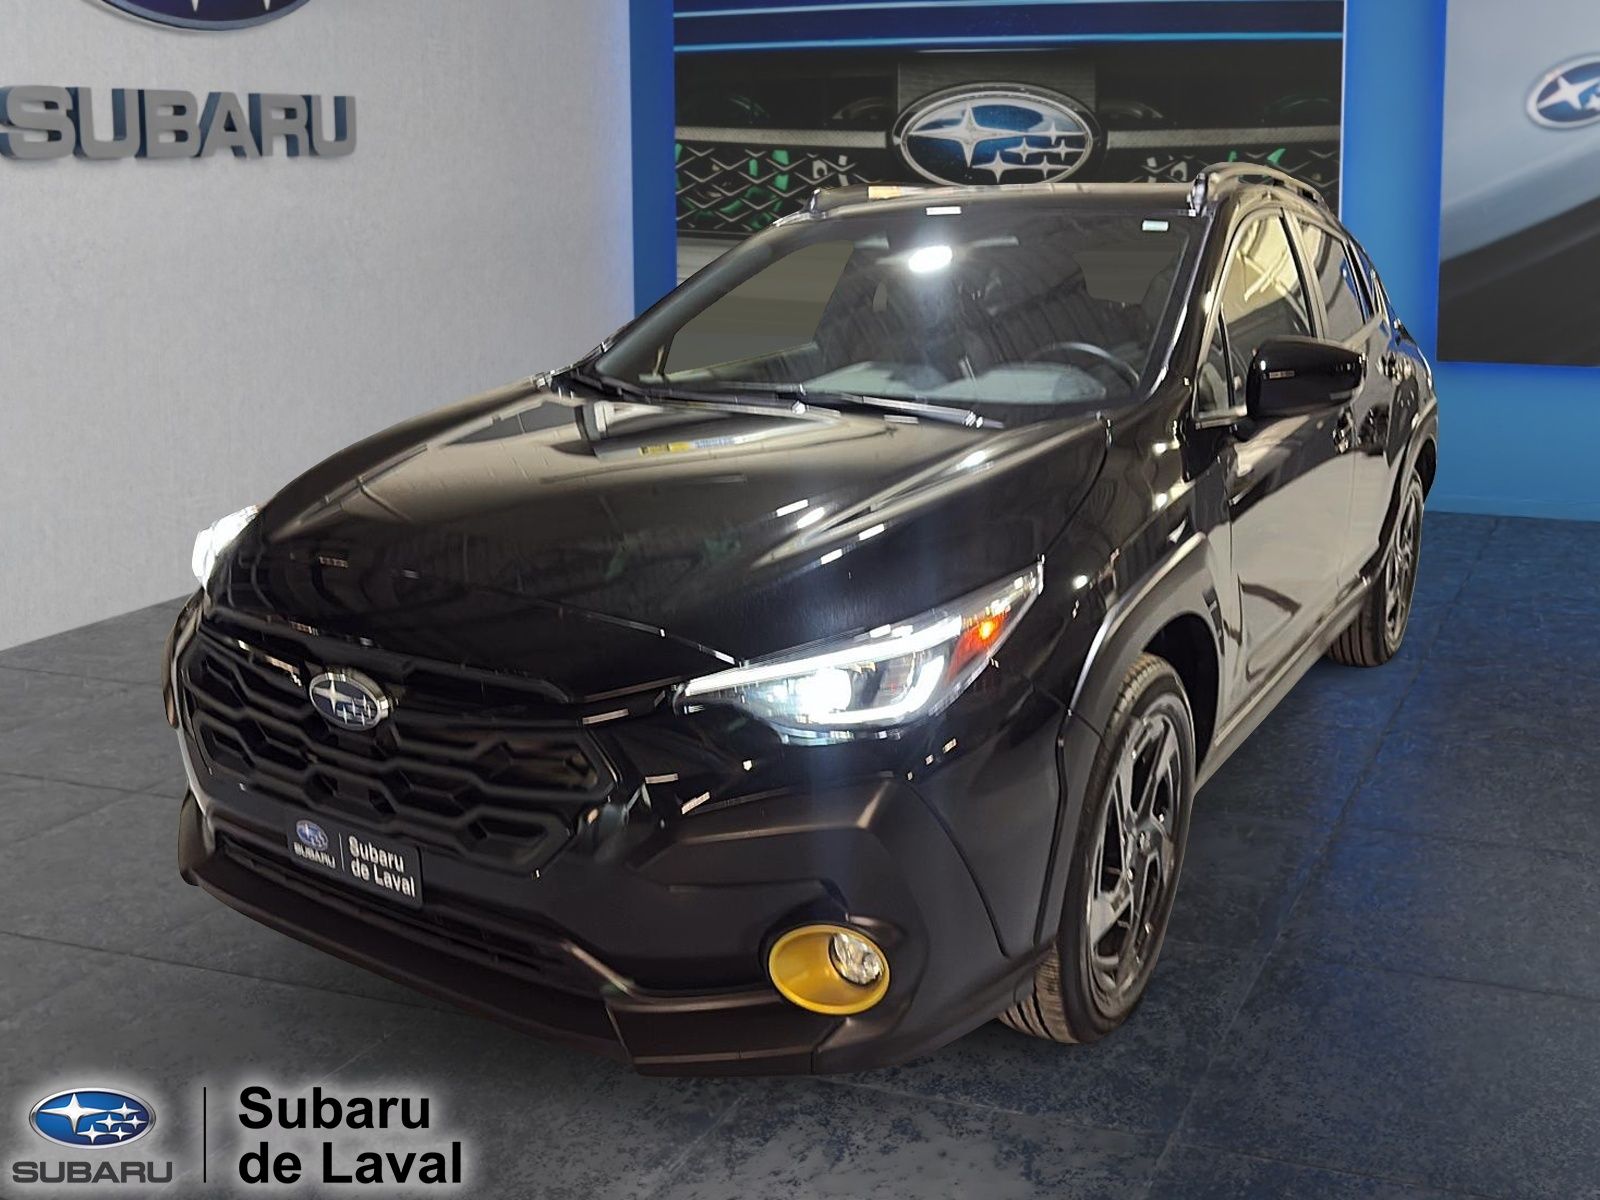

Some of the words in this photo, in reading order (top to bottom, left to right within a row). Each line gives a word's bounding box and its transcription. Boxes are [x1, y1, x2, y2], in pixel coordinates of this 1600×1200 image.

[0, 85, 356, 159] SUBARU
[349, 835, 404, 873] Subaru
[351, 857, 370, 881] de
[373, 864, 416, 898] Laval
